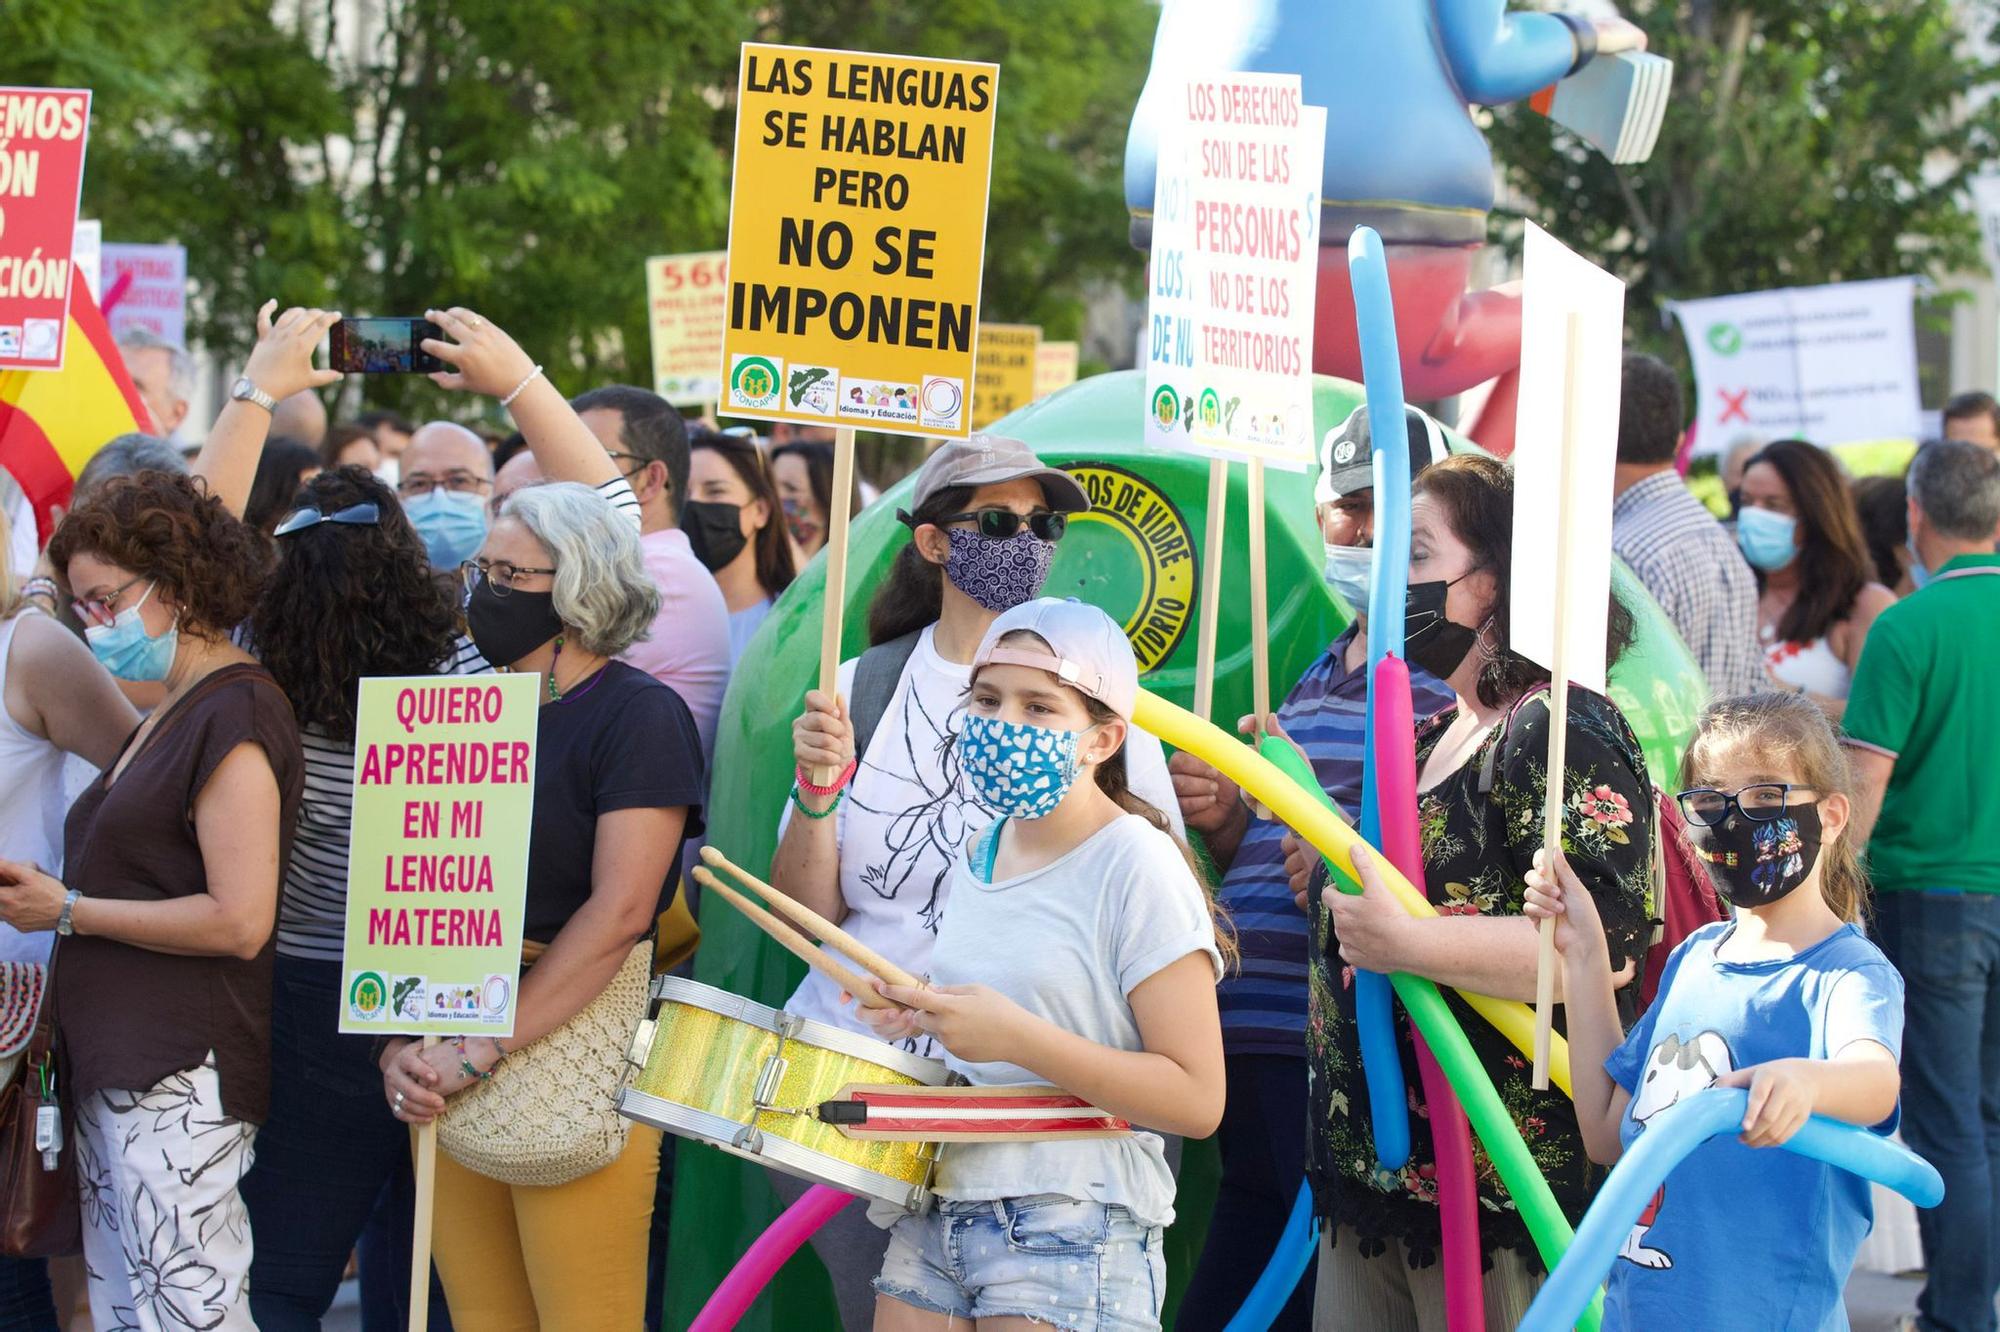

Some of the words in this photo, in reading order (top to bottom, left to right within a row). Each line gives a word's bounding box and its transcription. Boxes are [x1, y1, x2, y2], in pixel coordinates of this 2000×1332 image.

[748, 56, 812, 96] LAS
[827, 62, 989, 112] LENGUAS
[1188, 83, 1216, 122] LOS
[1221, 84, 1298, 128] DERECHOS
[763, 110, 808, 149] SE
[821, 115, 966, 164] HABLAN
[1202, 139, 1231, 179] SON
[1238, 142, 1257, 182] DE
[1263, 144, 1290, 185] LAS
[813, 167, 909, 212] PERO
[778, 217, 853, 270] NO
[872, 226, 937, 280] SE
[1195, 200, 1300, 263] PERSONAS
[1156, 249, 1184, 299] LOS
[1209, 271, 1229, 310] NO
[1235, 273, 1254, 314] DE
[1260, 276, 1289, 318] LOS
[731, 282, 972, 353] IMPONEN
[1151, 313, 1173, 365] DE
[1201, 324, 1301, 377] TERRITORIOS
[734, 389, 775, 408] CONCAPA
[839, 404, 869, 415] Idiomas
[871, 409, 876, 418] y
[878, 409, 917, 421] Educación
[1114, 482, 1147, 520] DE
[1138, 501, 1191, 569] VIDRE
[1132, 597, 1185, 667] VIDRIO
[396, 686, 503, 733] QUIERO
[360, 741, 530, 785] APRENDER
[403, 801, 440, 838] EN
[450, 800, 483, 838] MI
[384, 855, 494, 893] LENGUA
[368, 908, 503, 947] MATERNA
